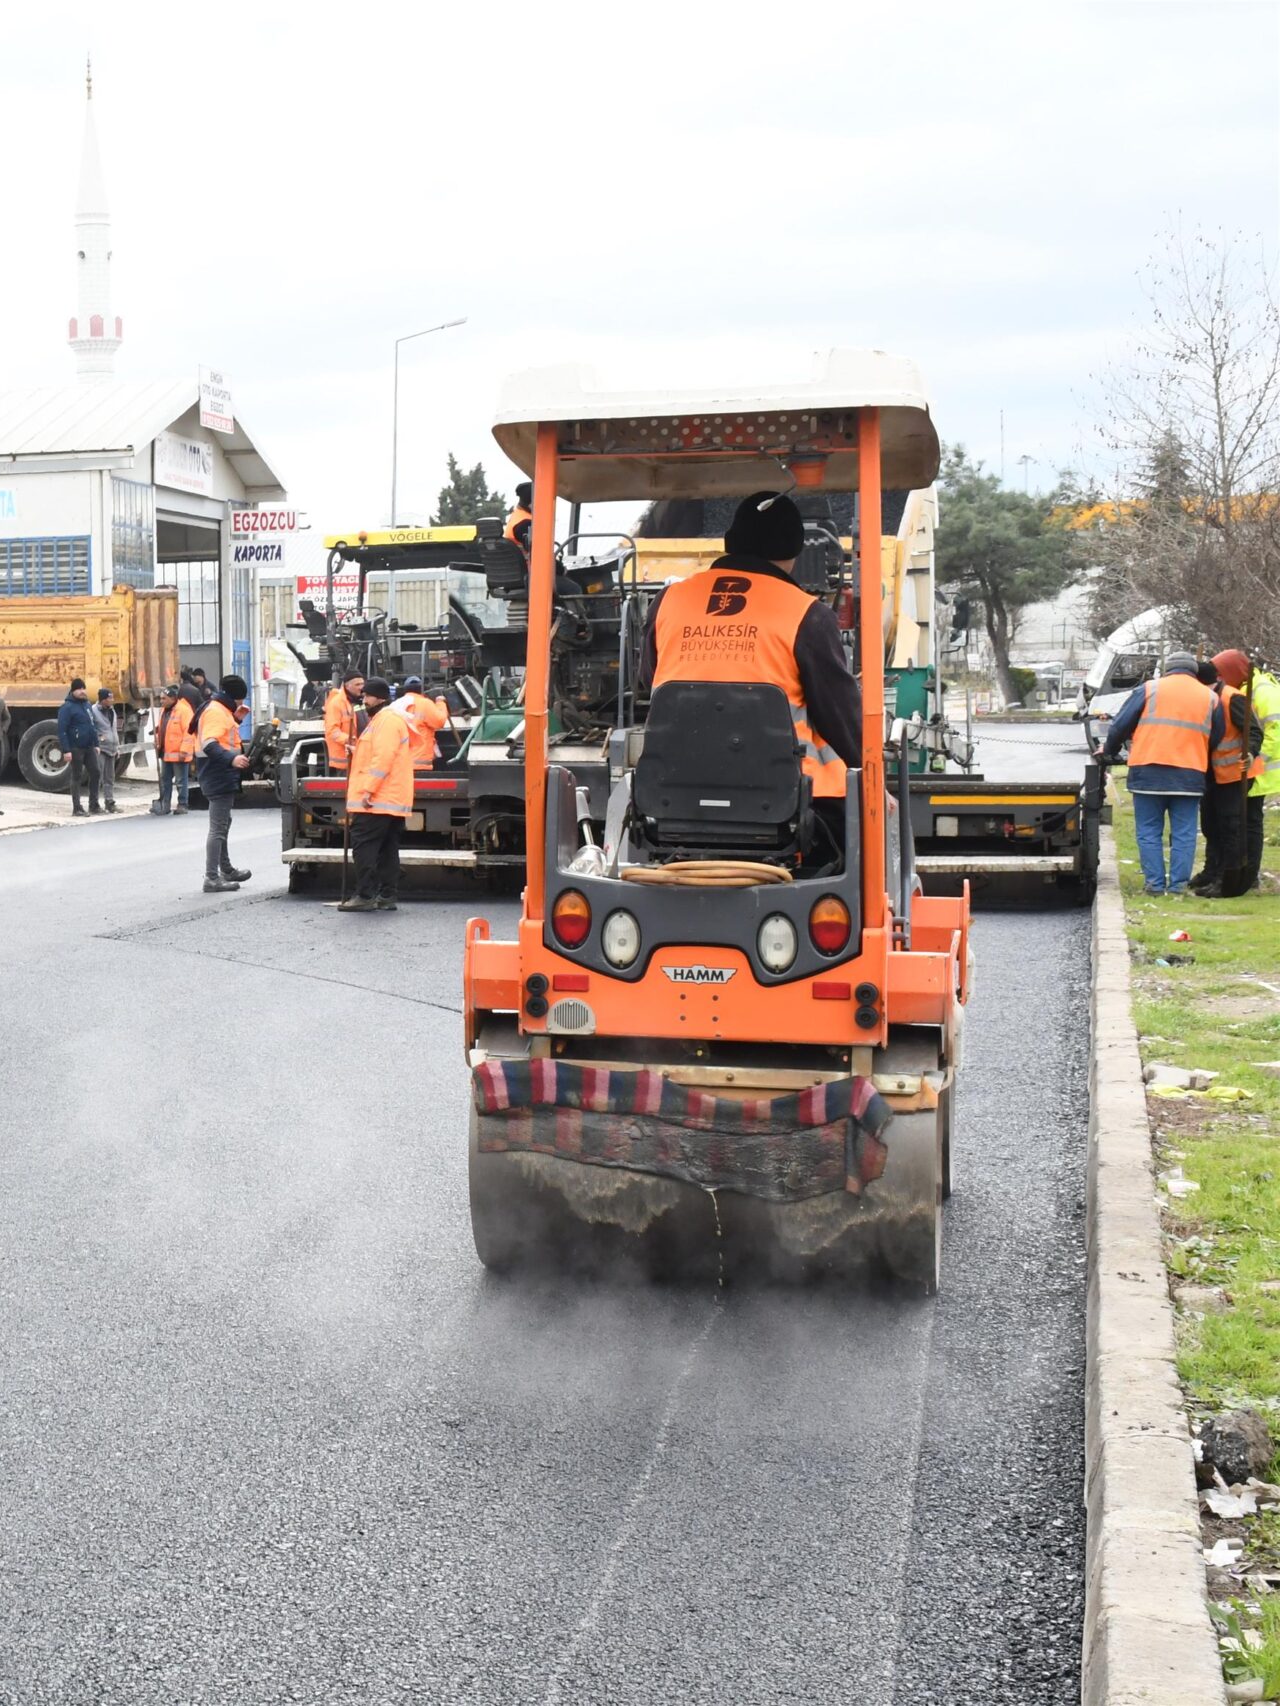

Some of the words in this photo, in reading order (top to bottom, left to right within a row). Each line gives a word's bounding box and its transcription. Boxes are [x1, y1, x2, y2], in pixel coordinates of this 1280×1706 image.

[233, 511, 296, 532] EGZOZCU
[389, 531, 433, 542] VÖGELE
[233, 544, 282, 562] KAPORTA
[682, 623, 758, 639] BALIKESİR
[680, 639, 756, 652] BÜYÜKŞEHİR
[673, 969, 724, 981] HAMM
